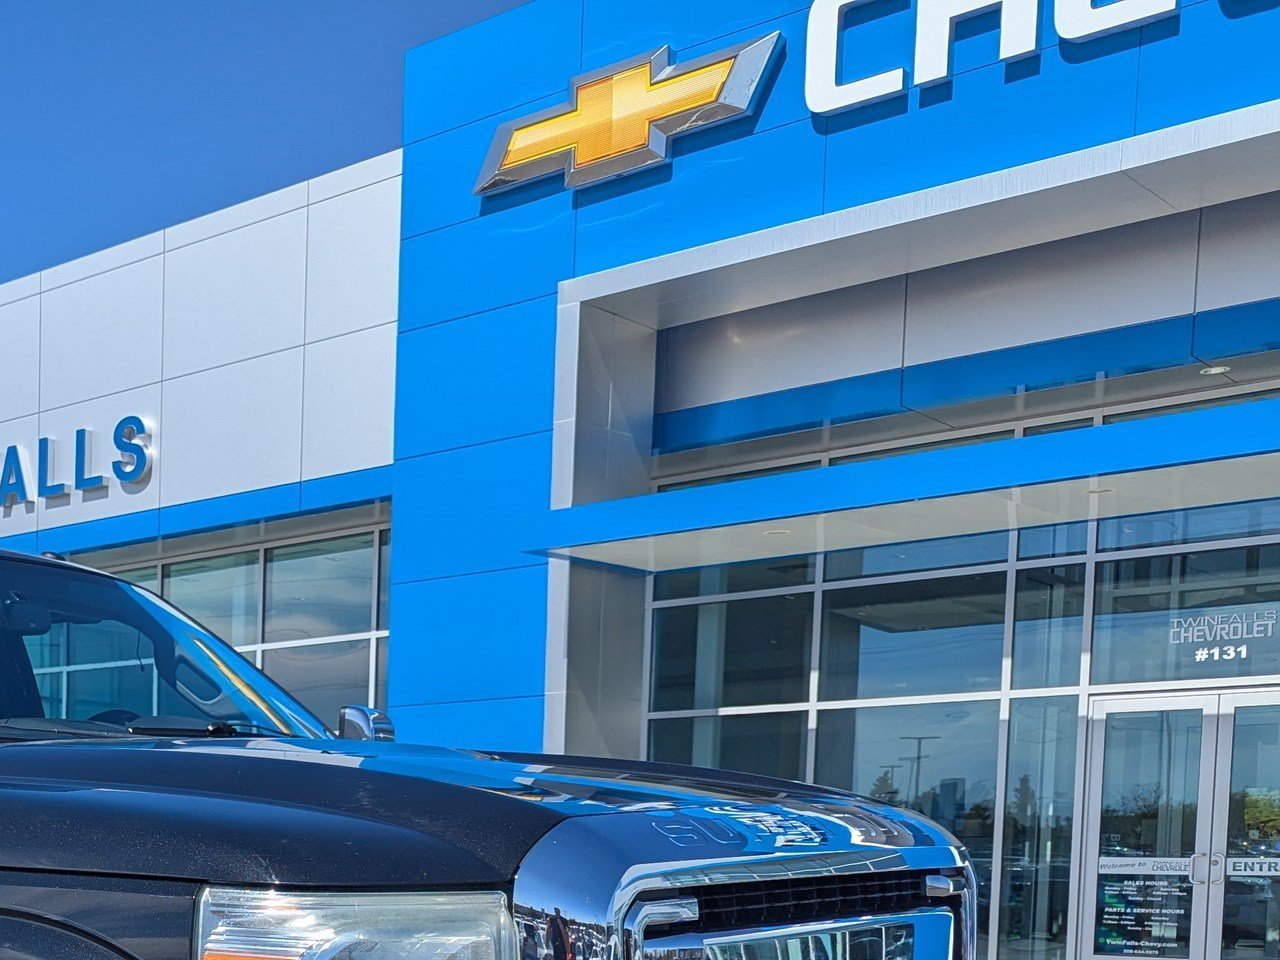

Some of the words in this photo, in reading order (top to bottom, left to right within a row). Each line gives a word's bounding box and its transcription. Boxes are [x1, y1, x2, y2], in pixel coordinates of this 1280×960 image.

[1170, 620, 1277, 644] CHEVROLET
[1194, 644, 1248, 662] #131
[1100, 862, 1137, 870] Welcome
